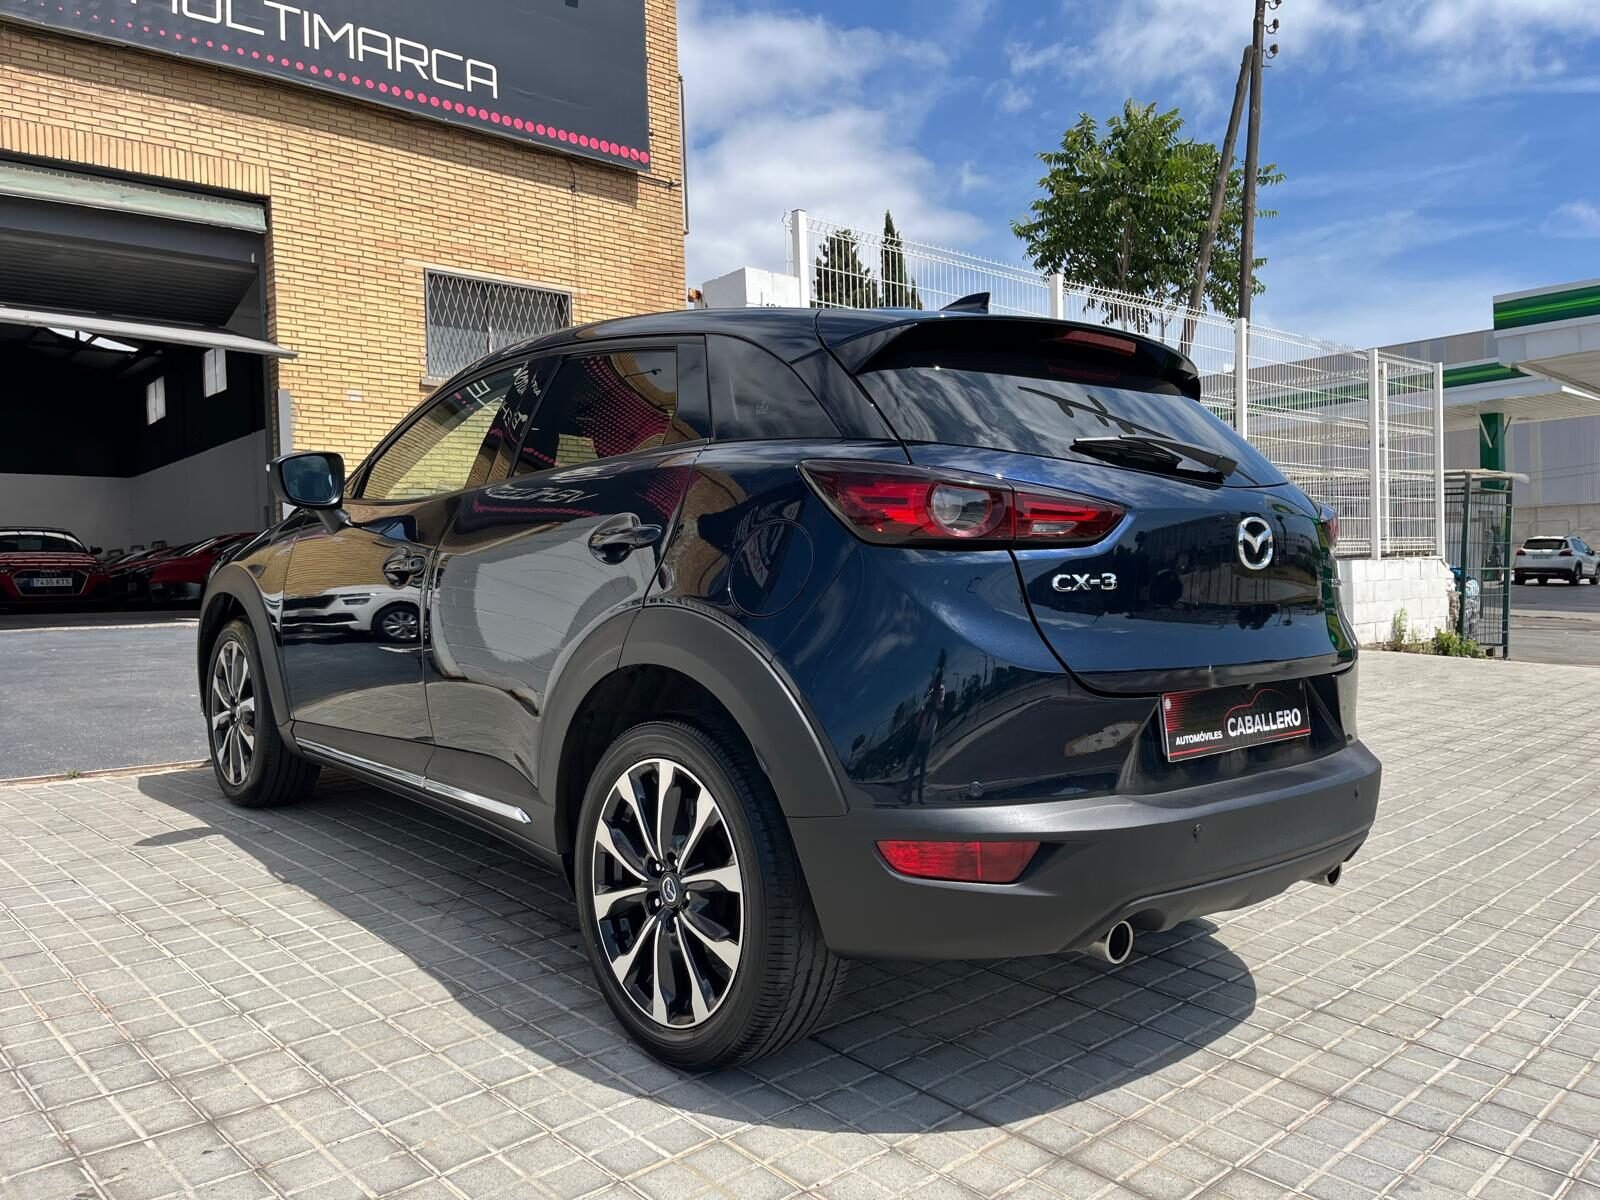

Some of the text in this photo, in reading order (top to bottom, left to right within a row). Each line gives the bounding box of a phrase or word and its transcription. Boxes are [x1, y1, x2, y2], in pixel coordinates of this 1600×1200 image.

[131, 0, 498, 99] ULTIMARCA
[1052, 573, 1118, 592] CX-3
[1175, 708, 1301, 746] AUTOMÓVILES CABALLERO
